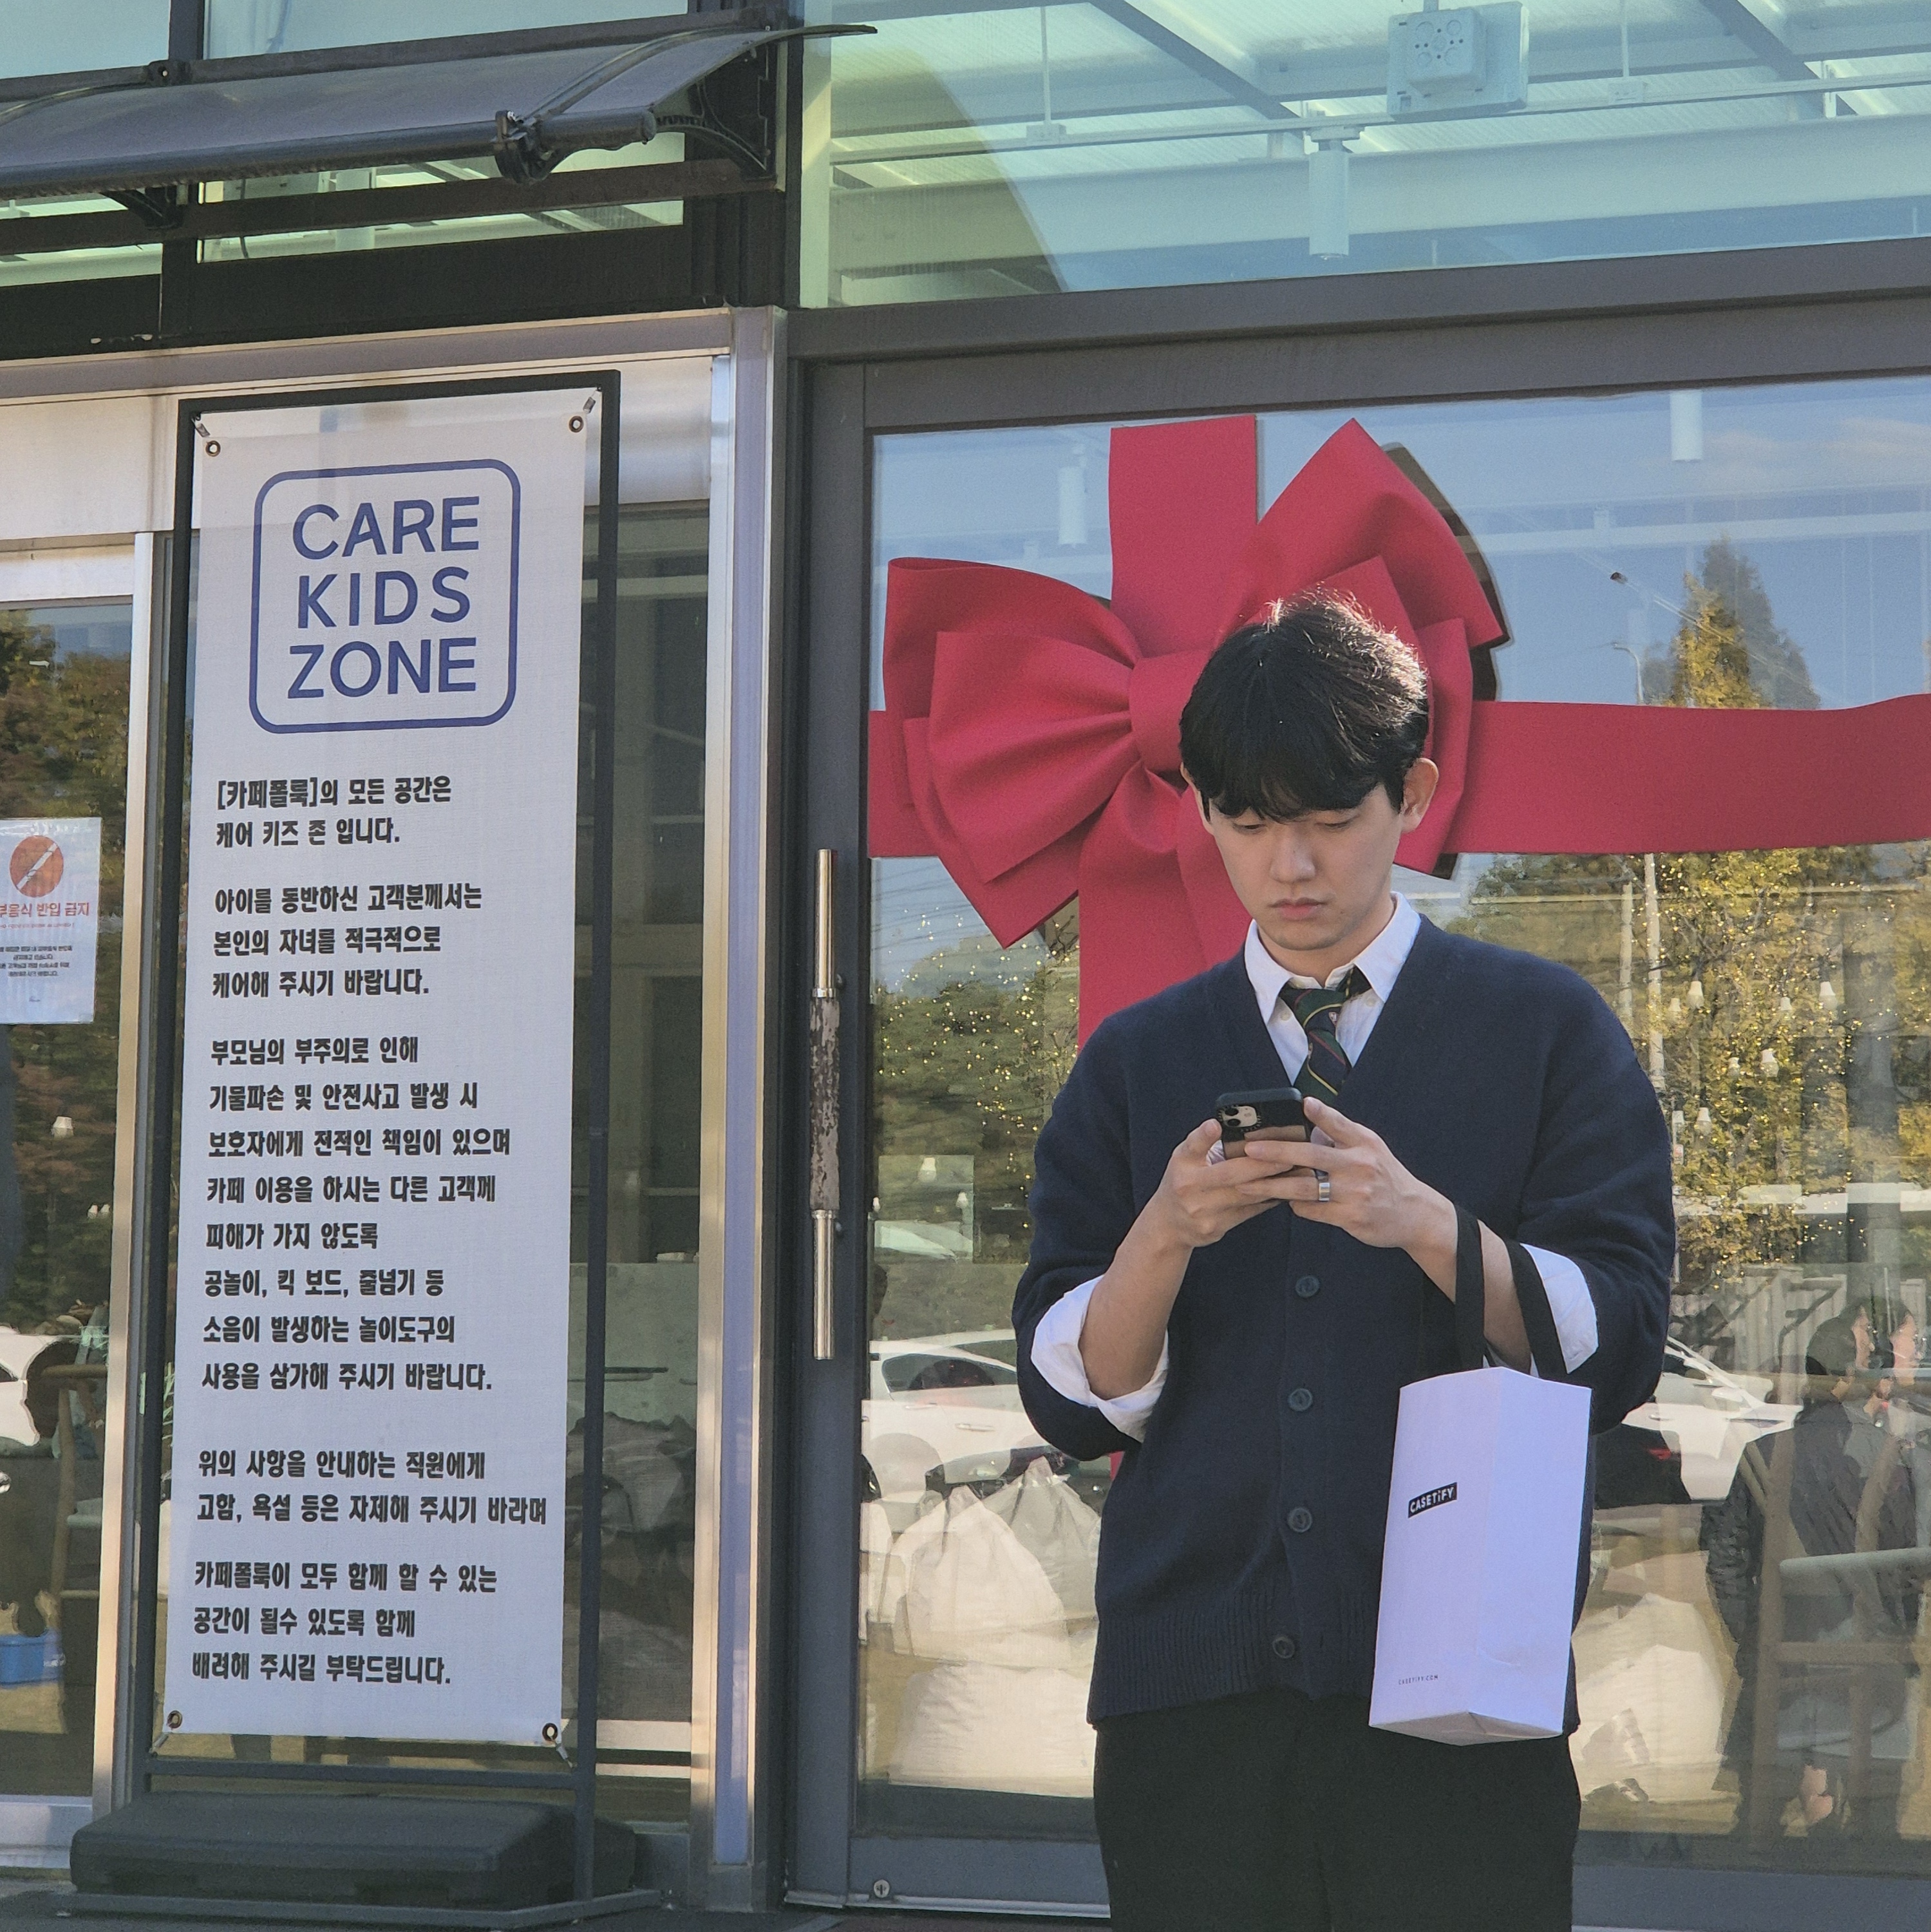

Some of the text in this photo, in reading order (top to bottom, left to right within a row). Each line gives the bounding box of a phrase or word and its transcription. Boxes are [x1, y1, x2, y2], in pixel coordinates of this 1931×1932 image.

[292, 496, 480, 560] CARE
[297, 566, 471, 629] KIDS
[287, 637, 476, 699] ZONE
[218, 775, 451, 810] [카페폴룩]의 모든 공간은
[216, 817, 400, 848] 케어 키즈 존 입니다.
[37, 903, 61, 916] 반입
[65, 902, 89, 916] 금지
[215, 882, 482, 915] 아이를 동반하신 고객분께서는
[213, 925, 441, 956] 본인의 자녀를 적극적으로
[212, 968, 429, 999] 케어해 주시기 바랍니다.
[211, 1036, 419, 1066] 부모님의 부주의로 인해
[209, 1082, 478, 1112] 기물파손 및 안전사고 발생 시
[209, 1128, 510, 1157] 보호자에게 전적인 책임이 있으며
[207, 1175, 496, 1204] 카페 이용을 하시는 다른 고객께
[206, 1222, 378, 1250] 피해가 가지 않도록
[204, 1268, 444, 1298] 공놀이, 킥 보드, 줄넘기 등
[203, 1315, 455, 1343] 소음이 발생하는 놀이도구의
[202, 1362, 492, 1390] 사용을 삼가해 주시기 바랍니다.
[198, 1449, 485, 1479] 위의 사항을 안내하는 직원에게
[197, 1493, 547, 1525] 고함, 욕설 등은 자제해 주시기 바라며
[194, 1561, 497, 1593] 카페폴룩이 모두 함께 할 수 있는
[194, 1606, 250, 1634] 공간이
[308, 1608, 365, 1636] 있도록
[375, 1609, 415, 1638] 함께
[192, 1652, 451, 1685] 배려해 주시길 부탁드립니다.
